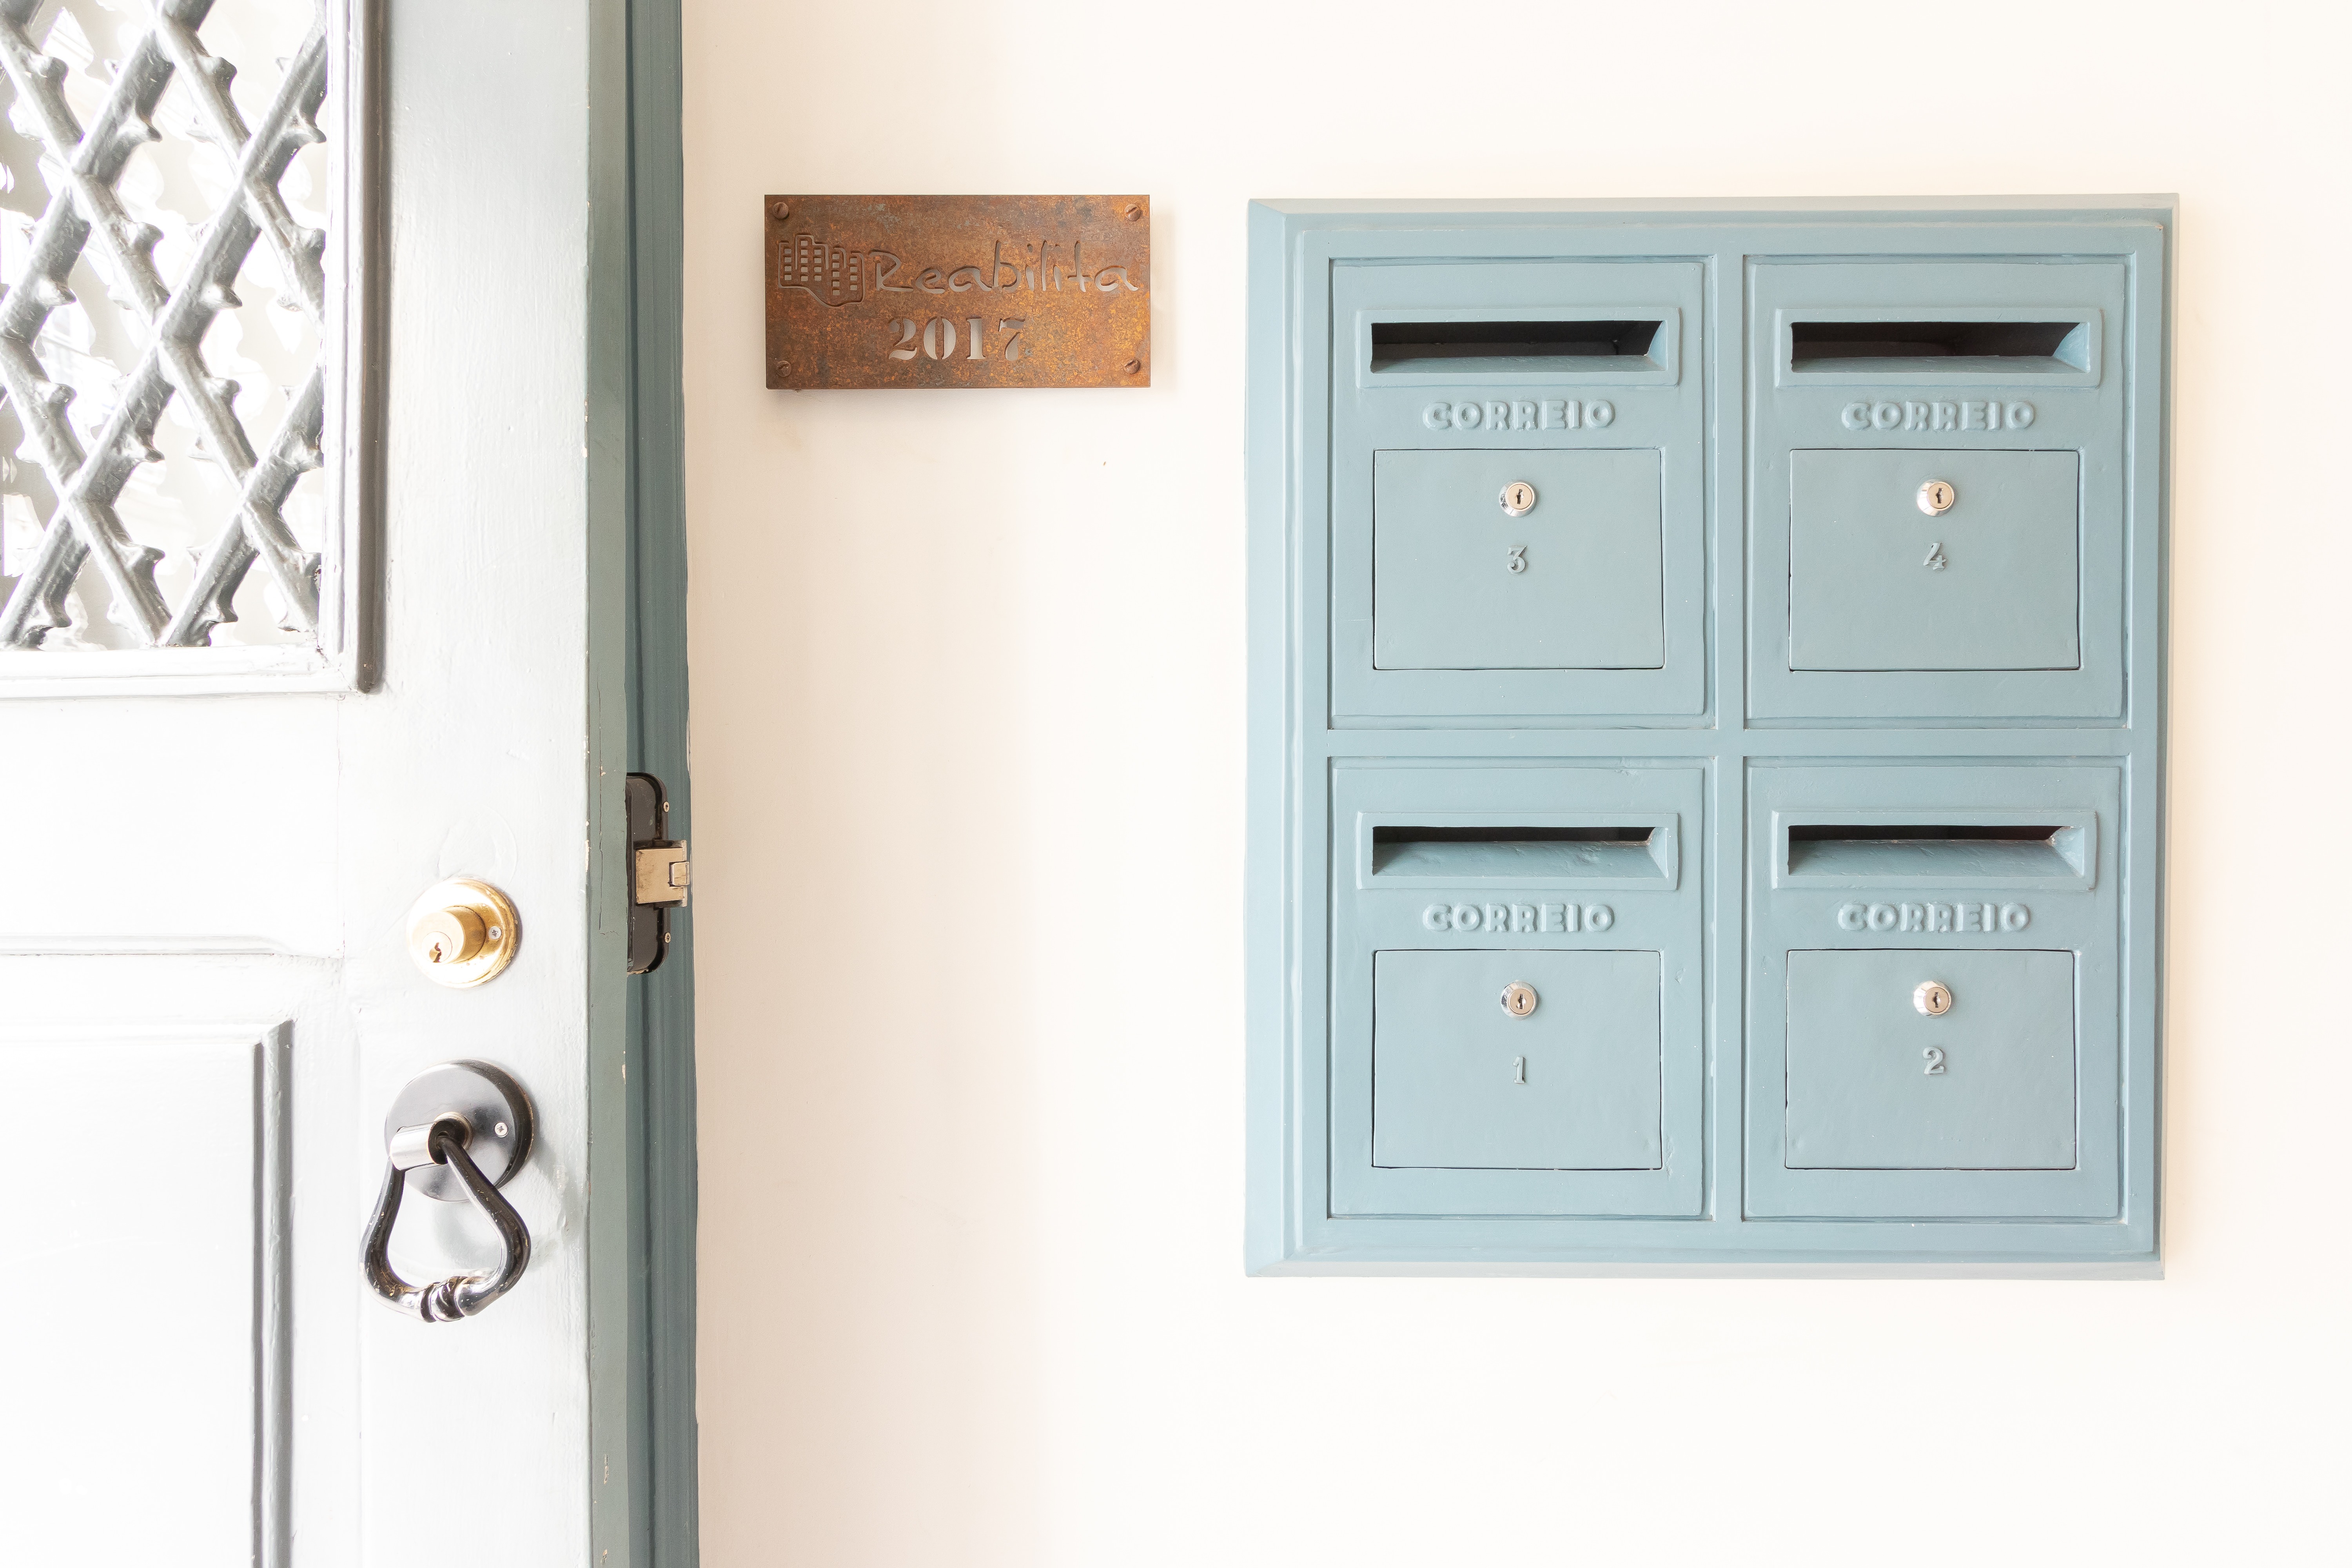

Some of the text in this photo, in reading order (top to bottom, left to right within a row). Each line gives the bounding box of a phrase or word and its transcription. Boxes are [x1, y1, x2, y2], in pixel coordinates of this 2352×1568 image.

[868, 240, 1139, 294] Reabilita
[888, 317, 1026, 361] 2017
[1423, 400, 1615, 430] CORREIO
[1841, 401, 2034, 431] CORREIO
[1507, 545, 1528, 574] 3
[1923, 542, 1947, 571] 4
[1423, 902, 1614, 932] CORREIO
[1838, 903, 2031, 933] CORREIO
[1513, 1057, 1526, 1084] 1
[1923, 1046, 1945, 1075] 2
